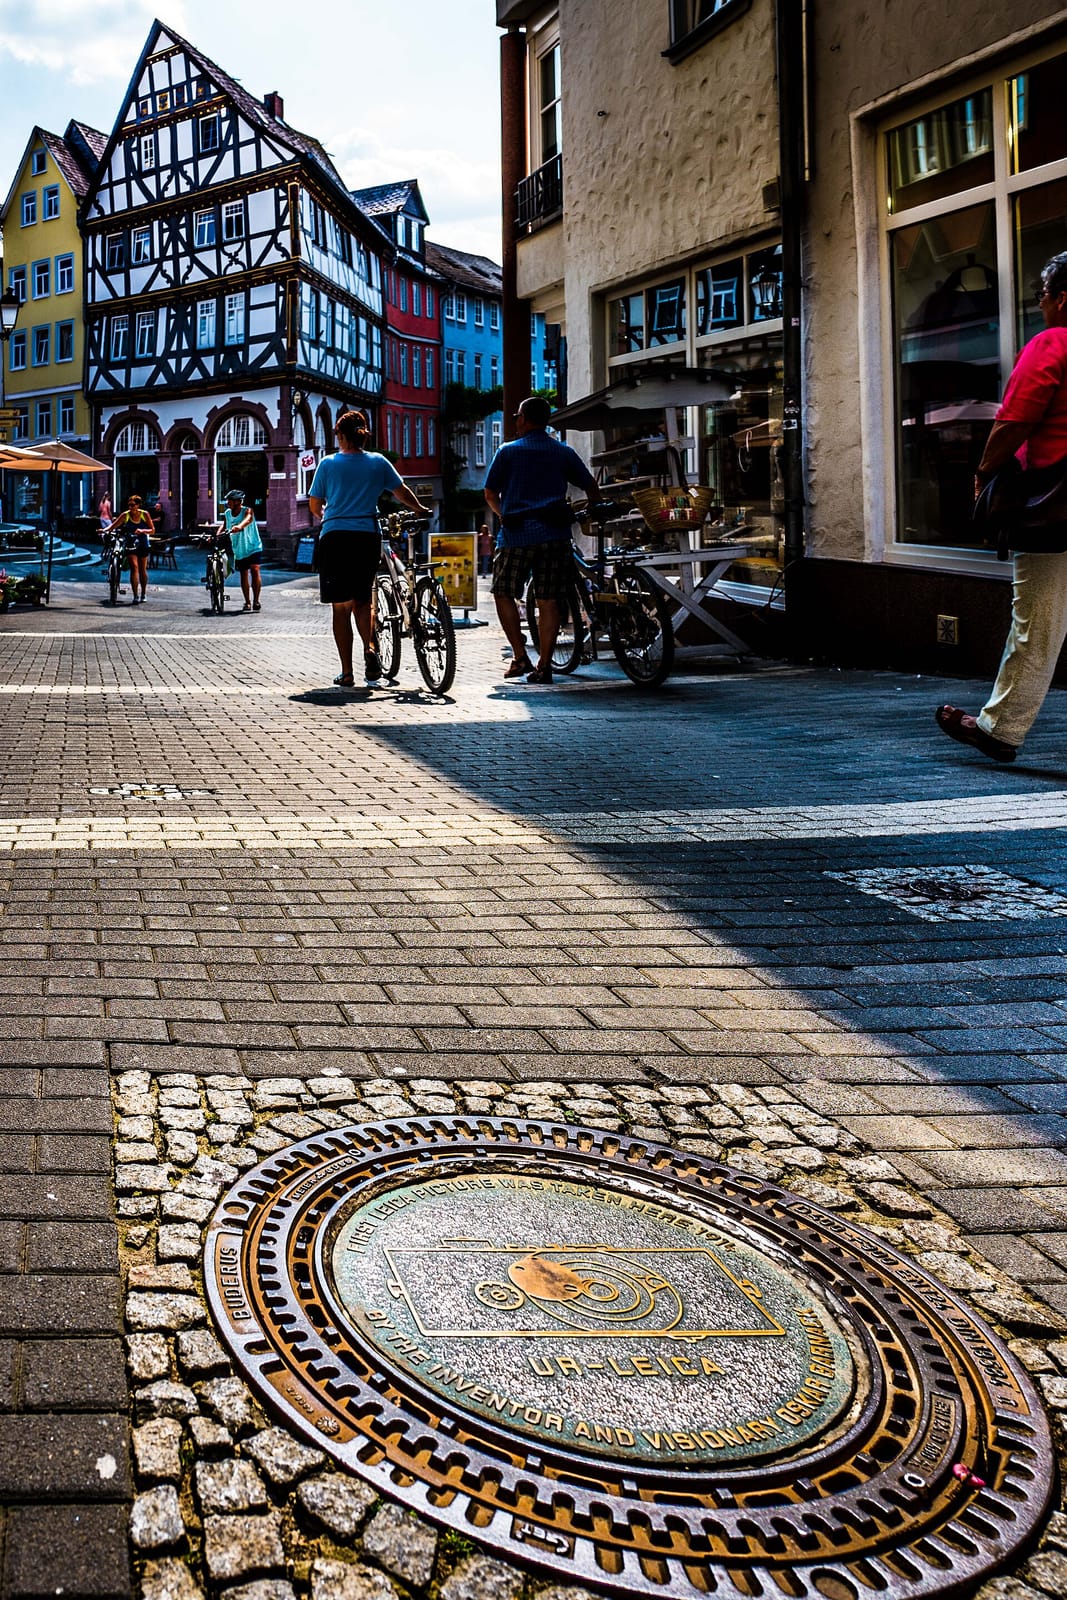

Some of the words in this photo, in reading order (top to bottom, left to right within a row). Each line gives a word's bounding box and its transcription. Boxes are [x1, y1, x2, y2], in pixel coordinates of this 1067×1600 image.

[346, 1217, 379, 1255] FIRST
[367, 1194, 417, 1221] LEICA
[410, 1178, 496, 1200] PICTURE
[497, 1178, 545, 1191] WAS
[550, 1182, 623, 1206] TAKEN
[628, 1200, 694, 1230] HERE
[695, 1225, 738, 1253] 1914
[219, 1246, 252, 1320] BUDERUS
[364, 1309, 396, 1330] BY
[386, 1331, 432, 1366] THE
[793, 1306, 836, 1380] BARNACK
[527, 1355, 726, 1377] UR-LEICA
[426, 1363, 564, 1433] INVENTOR
[775, 1376, 833, 1426] OSKAR
[574, 1420, 636, 1447] AND
[641, 1415, 784, 1451] VISIONARY
